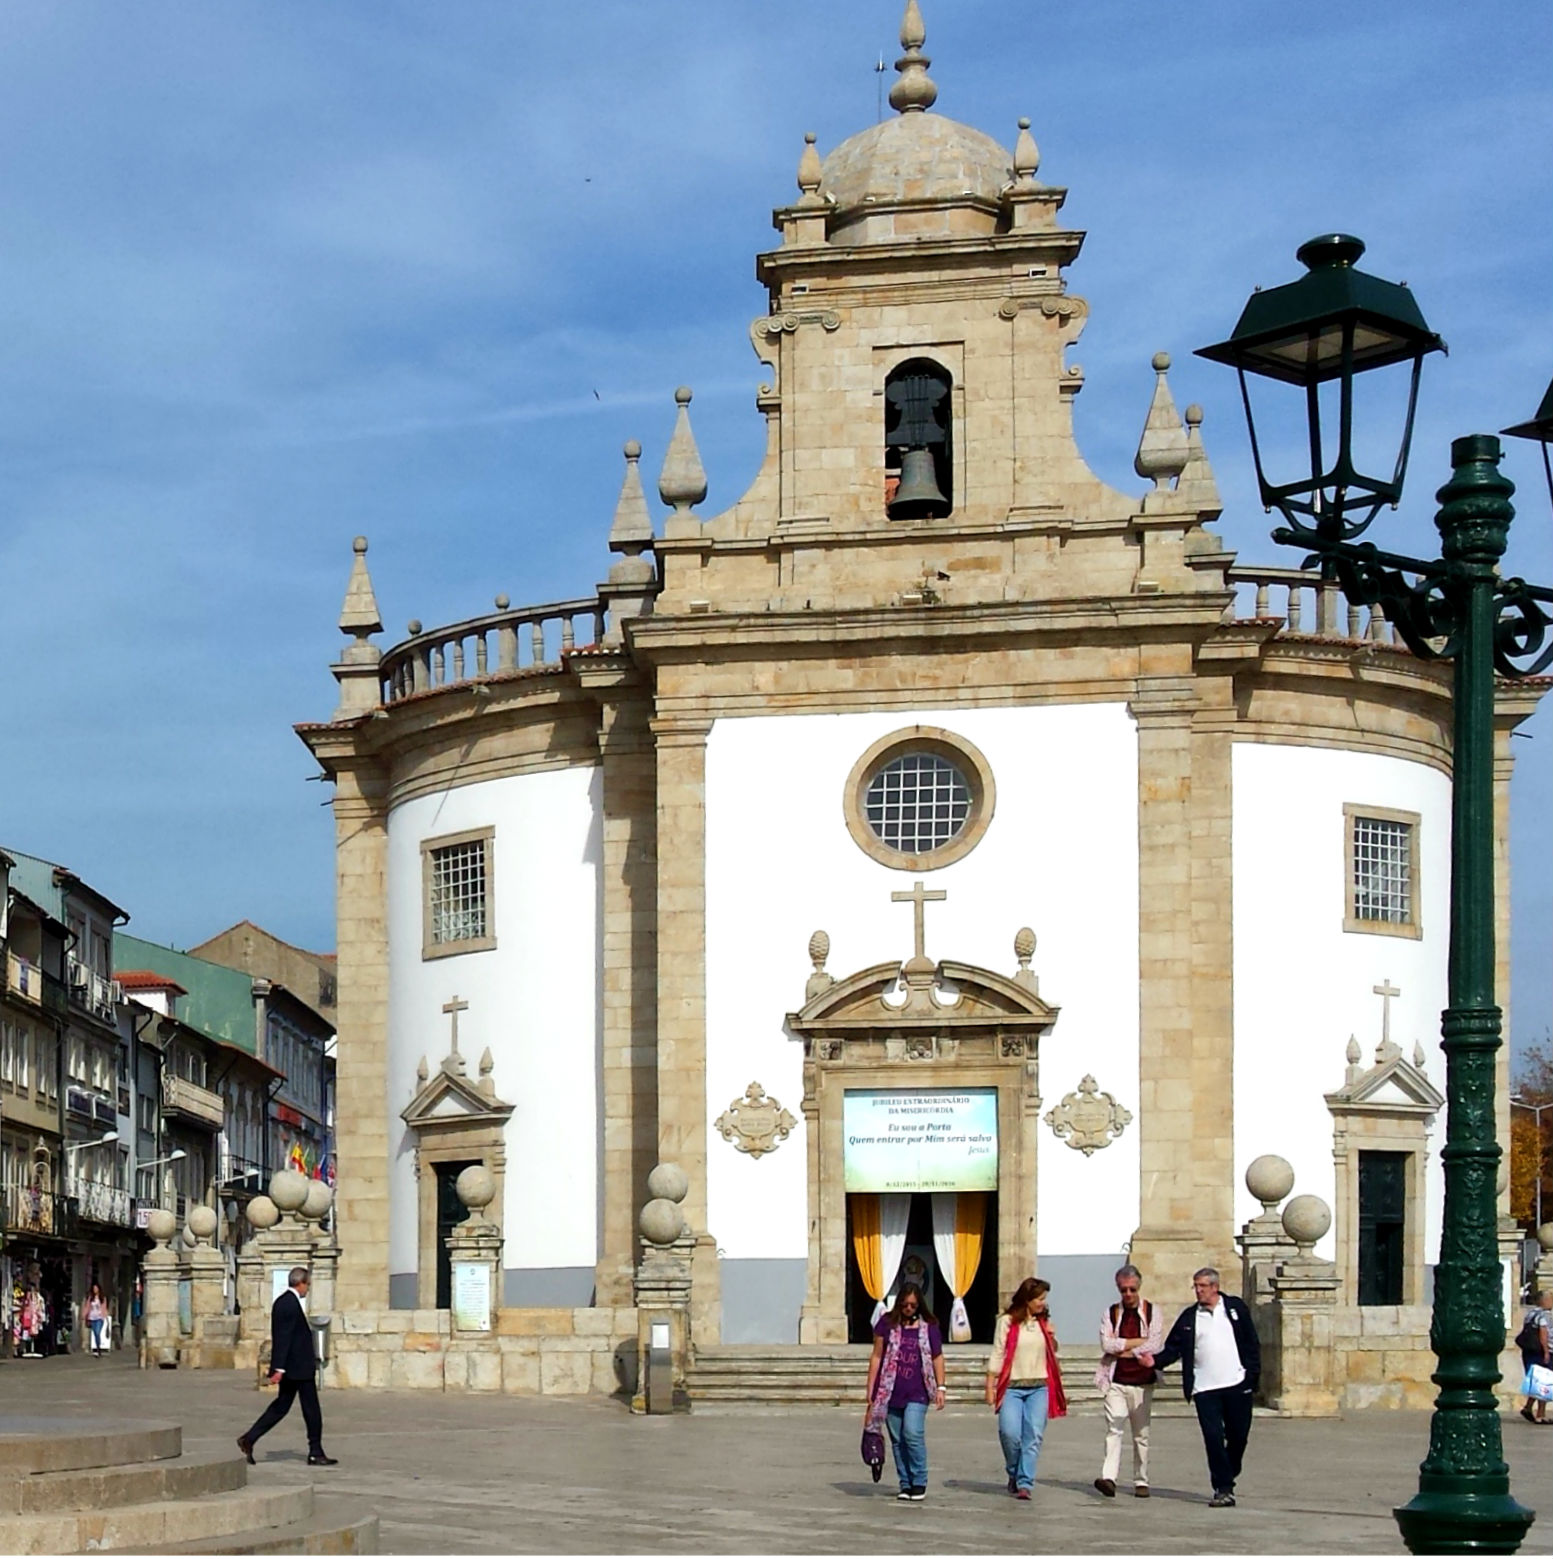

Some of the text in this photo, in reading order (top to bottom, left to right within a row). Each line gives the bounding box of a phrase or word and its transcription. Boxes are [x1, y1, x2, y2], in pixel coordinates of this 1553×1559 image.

[888, 1123, 899, 1132] Eu
[926, 1122, 952, 1131] Porta
[849, 1135, 875, 1146] Quem
[906, 1136, 923, 1145] por
[924, 1134, 945, 1143] Mim
[968, 1133, 992, 1142] salvo
